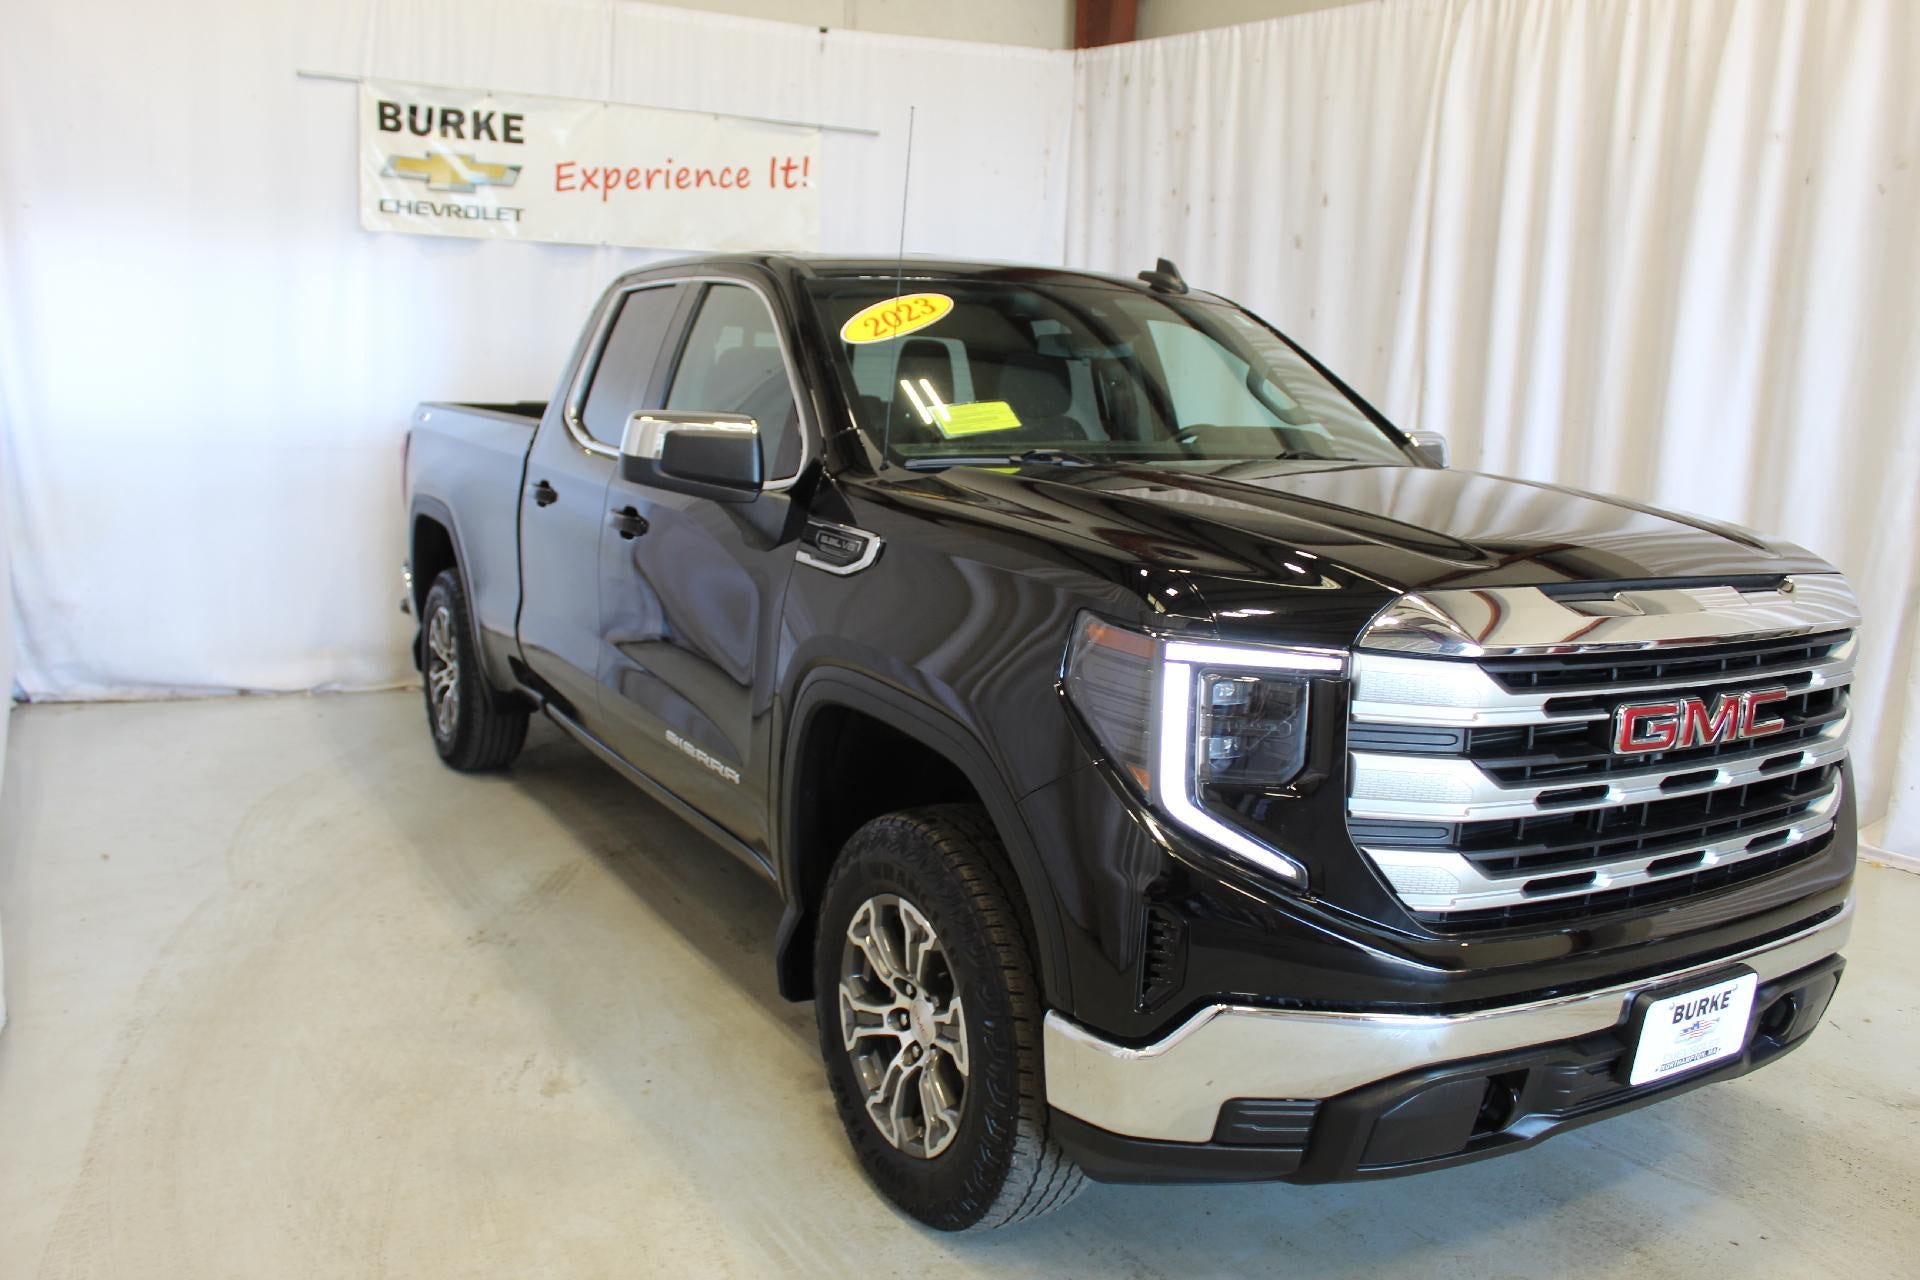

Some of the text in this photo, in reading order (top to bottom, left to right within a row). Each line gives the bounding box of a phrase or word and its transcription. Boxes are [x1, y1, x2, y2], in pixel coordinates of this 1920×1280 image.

[378, 100, 525, 144] BURKE
[554, 155, 810, 202] Experience It!
[378, 199, 525, 222] CHEVROLET
[863, 297, 937, 338] 2023
[1613, 686, 1789, 755] GMC
[665, 729, 740, 785] SIERRA
[1672, 990, 1731, 1024] BURKE
